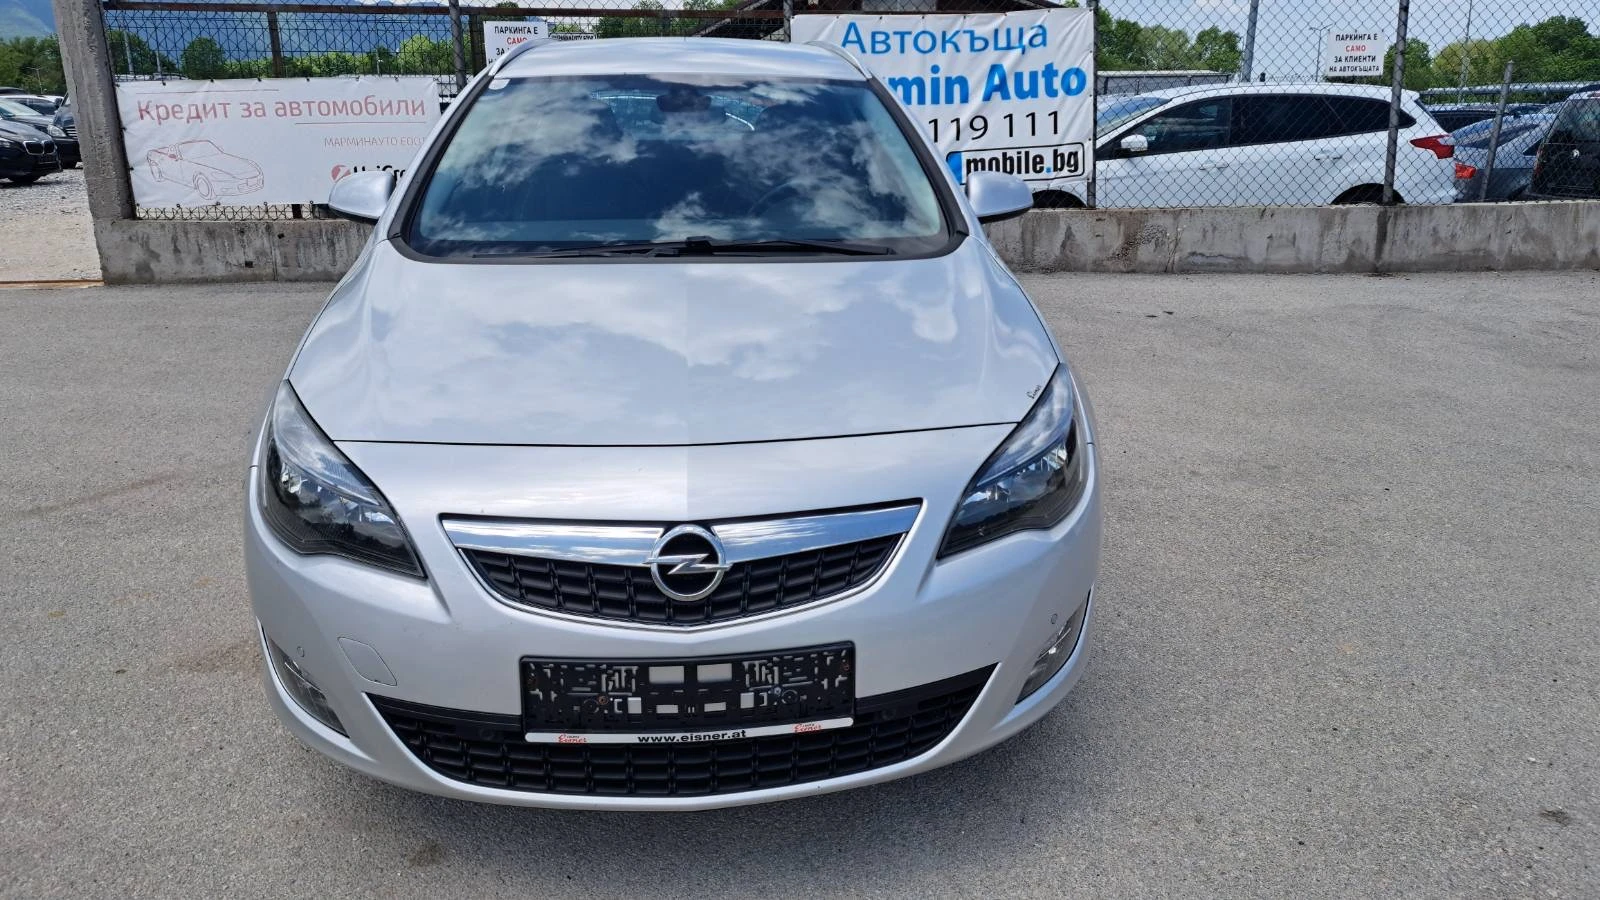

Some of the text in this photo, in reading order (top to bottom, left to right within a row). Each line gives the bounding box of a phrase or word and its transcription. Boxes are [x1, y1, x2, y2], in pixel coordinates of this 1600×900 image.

[494, 26, 539, 34] ПАРКИНГА Е
[842, 22, 1047, 54] Автокъща
[1335, 33, 1371, 41] ПАРКИНГА
[1334, 55, 1376, 63] ЗА КЛИЕНТИ
[982, 63, 1087, 101] Auto
[137, 95, 426, 125] Кредит за автомобили
[928, 111, 1059, 144] 119 111
[324, 136, 398, 147] МАРМИНАУТО
[965, 148, 1080, 176] mobile.bg
[637, 729, 747, 743] www.eisner.at
